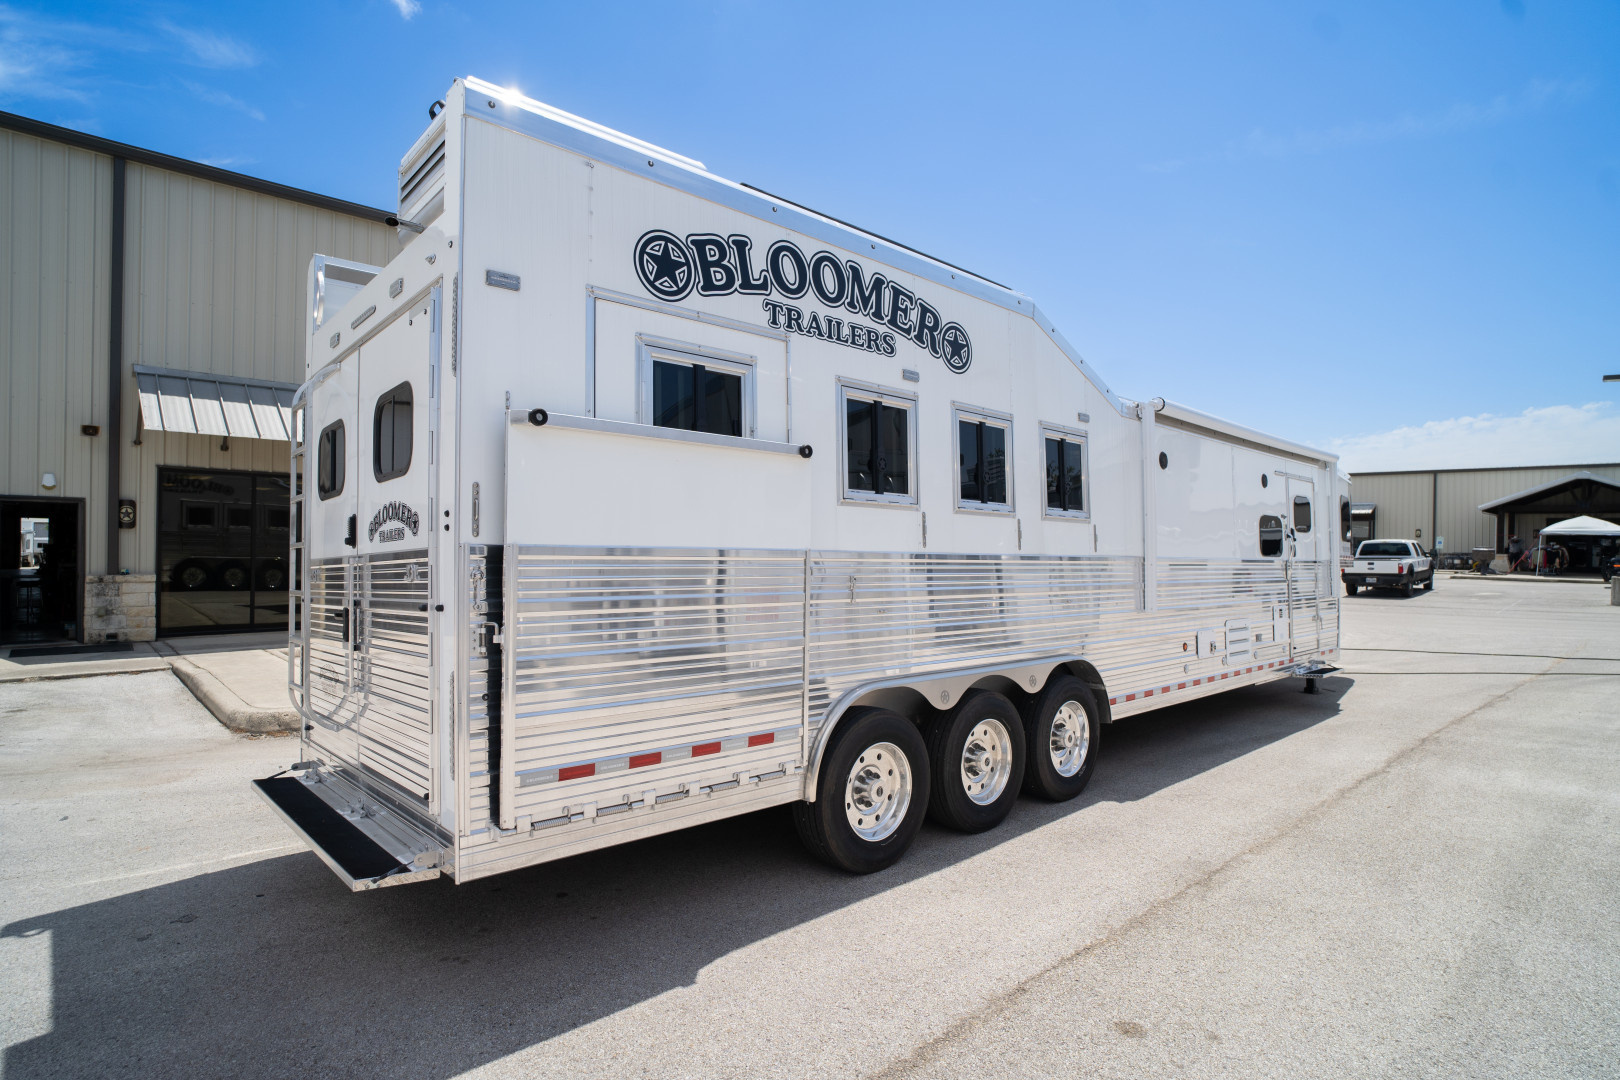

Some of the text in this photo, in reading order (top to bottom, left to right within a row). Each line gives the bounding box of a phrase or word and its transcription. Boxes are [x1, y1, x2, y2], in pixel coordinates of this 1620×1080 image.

[686, 233, 943, 359] BLOOMER
[762, 299, 897, 358] TRAILERS
[373, 501, 413, 534] BLOOMER
